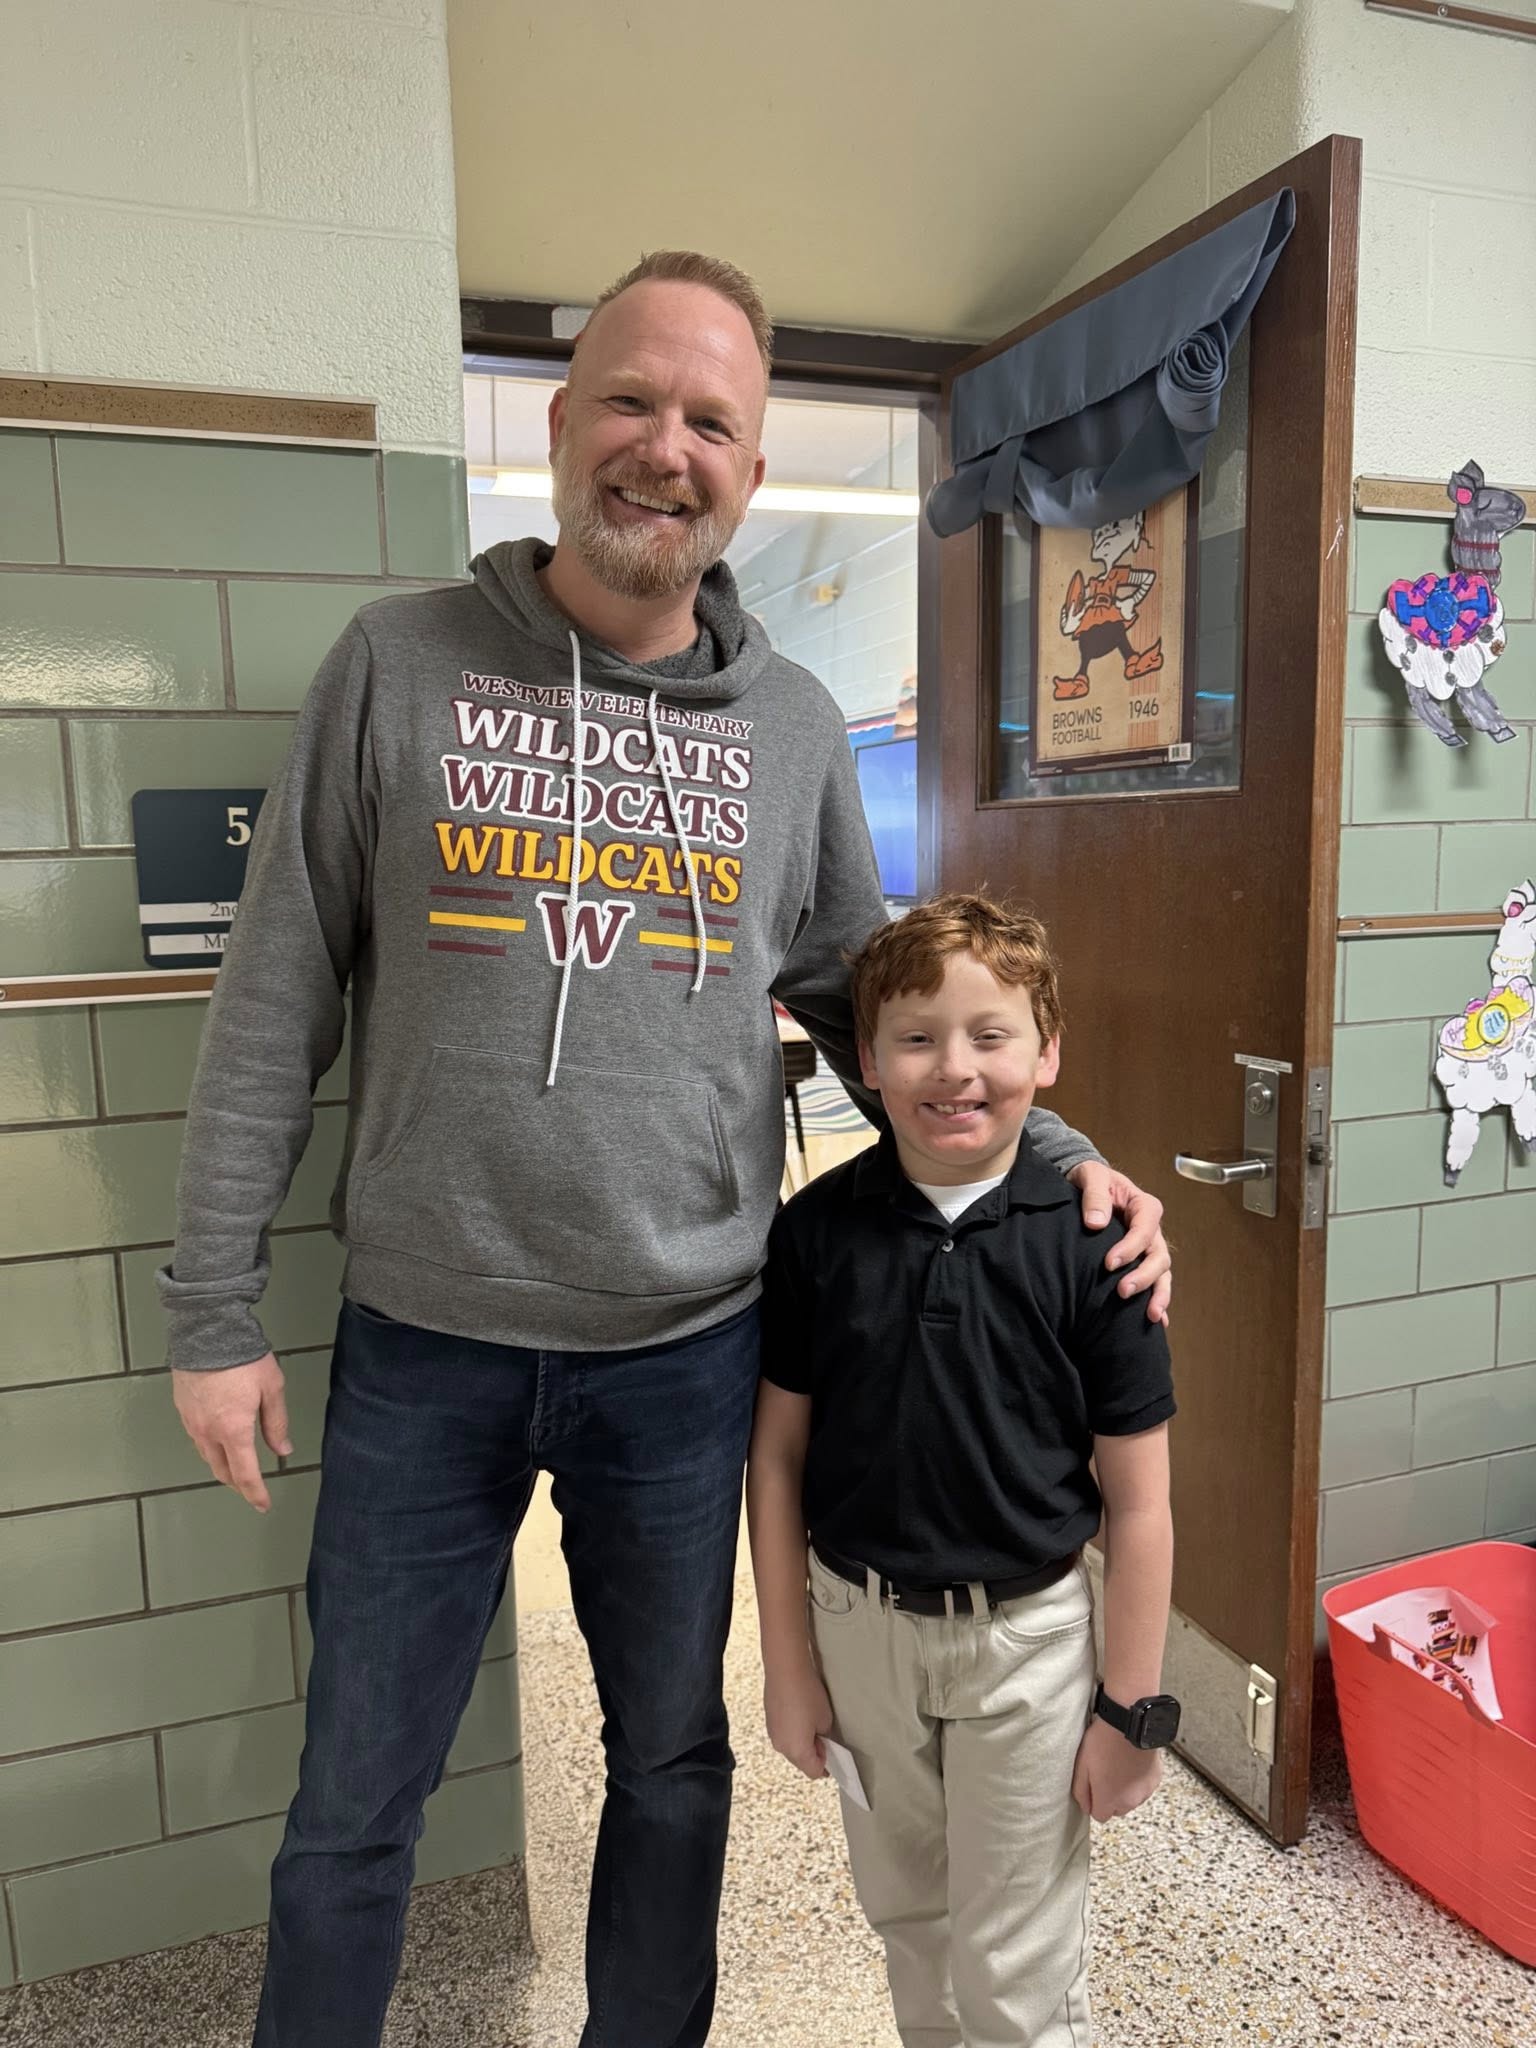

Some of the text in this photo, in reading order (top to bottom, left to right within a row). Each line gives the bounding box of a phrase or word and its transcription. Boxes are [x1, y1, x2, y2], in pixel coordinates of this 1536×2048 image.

[462, 671, 753, 740] WESTVIEW ELEMENTARY
[1052, 706, 1102, 730] BROWNS
[1052, 725, 1102, 745] FOOTBALL
[1129, 698, 1159, 719] 1946
[450, 698, 752, 791] WILDCATS
[440, 754, 749, 849] WILDCATS
[434, 821, 742, 906] WILDCATS
[536, 891, 635, 970] W
